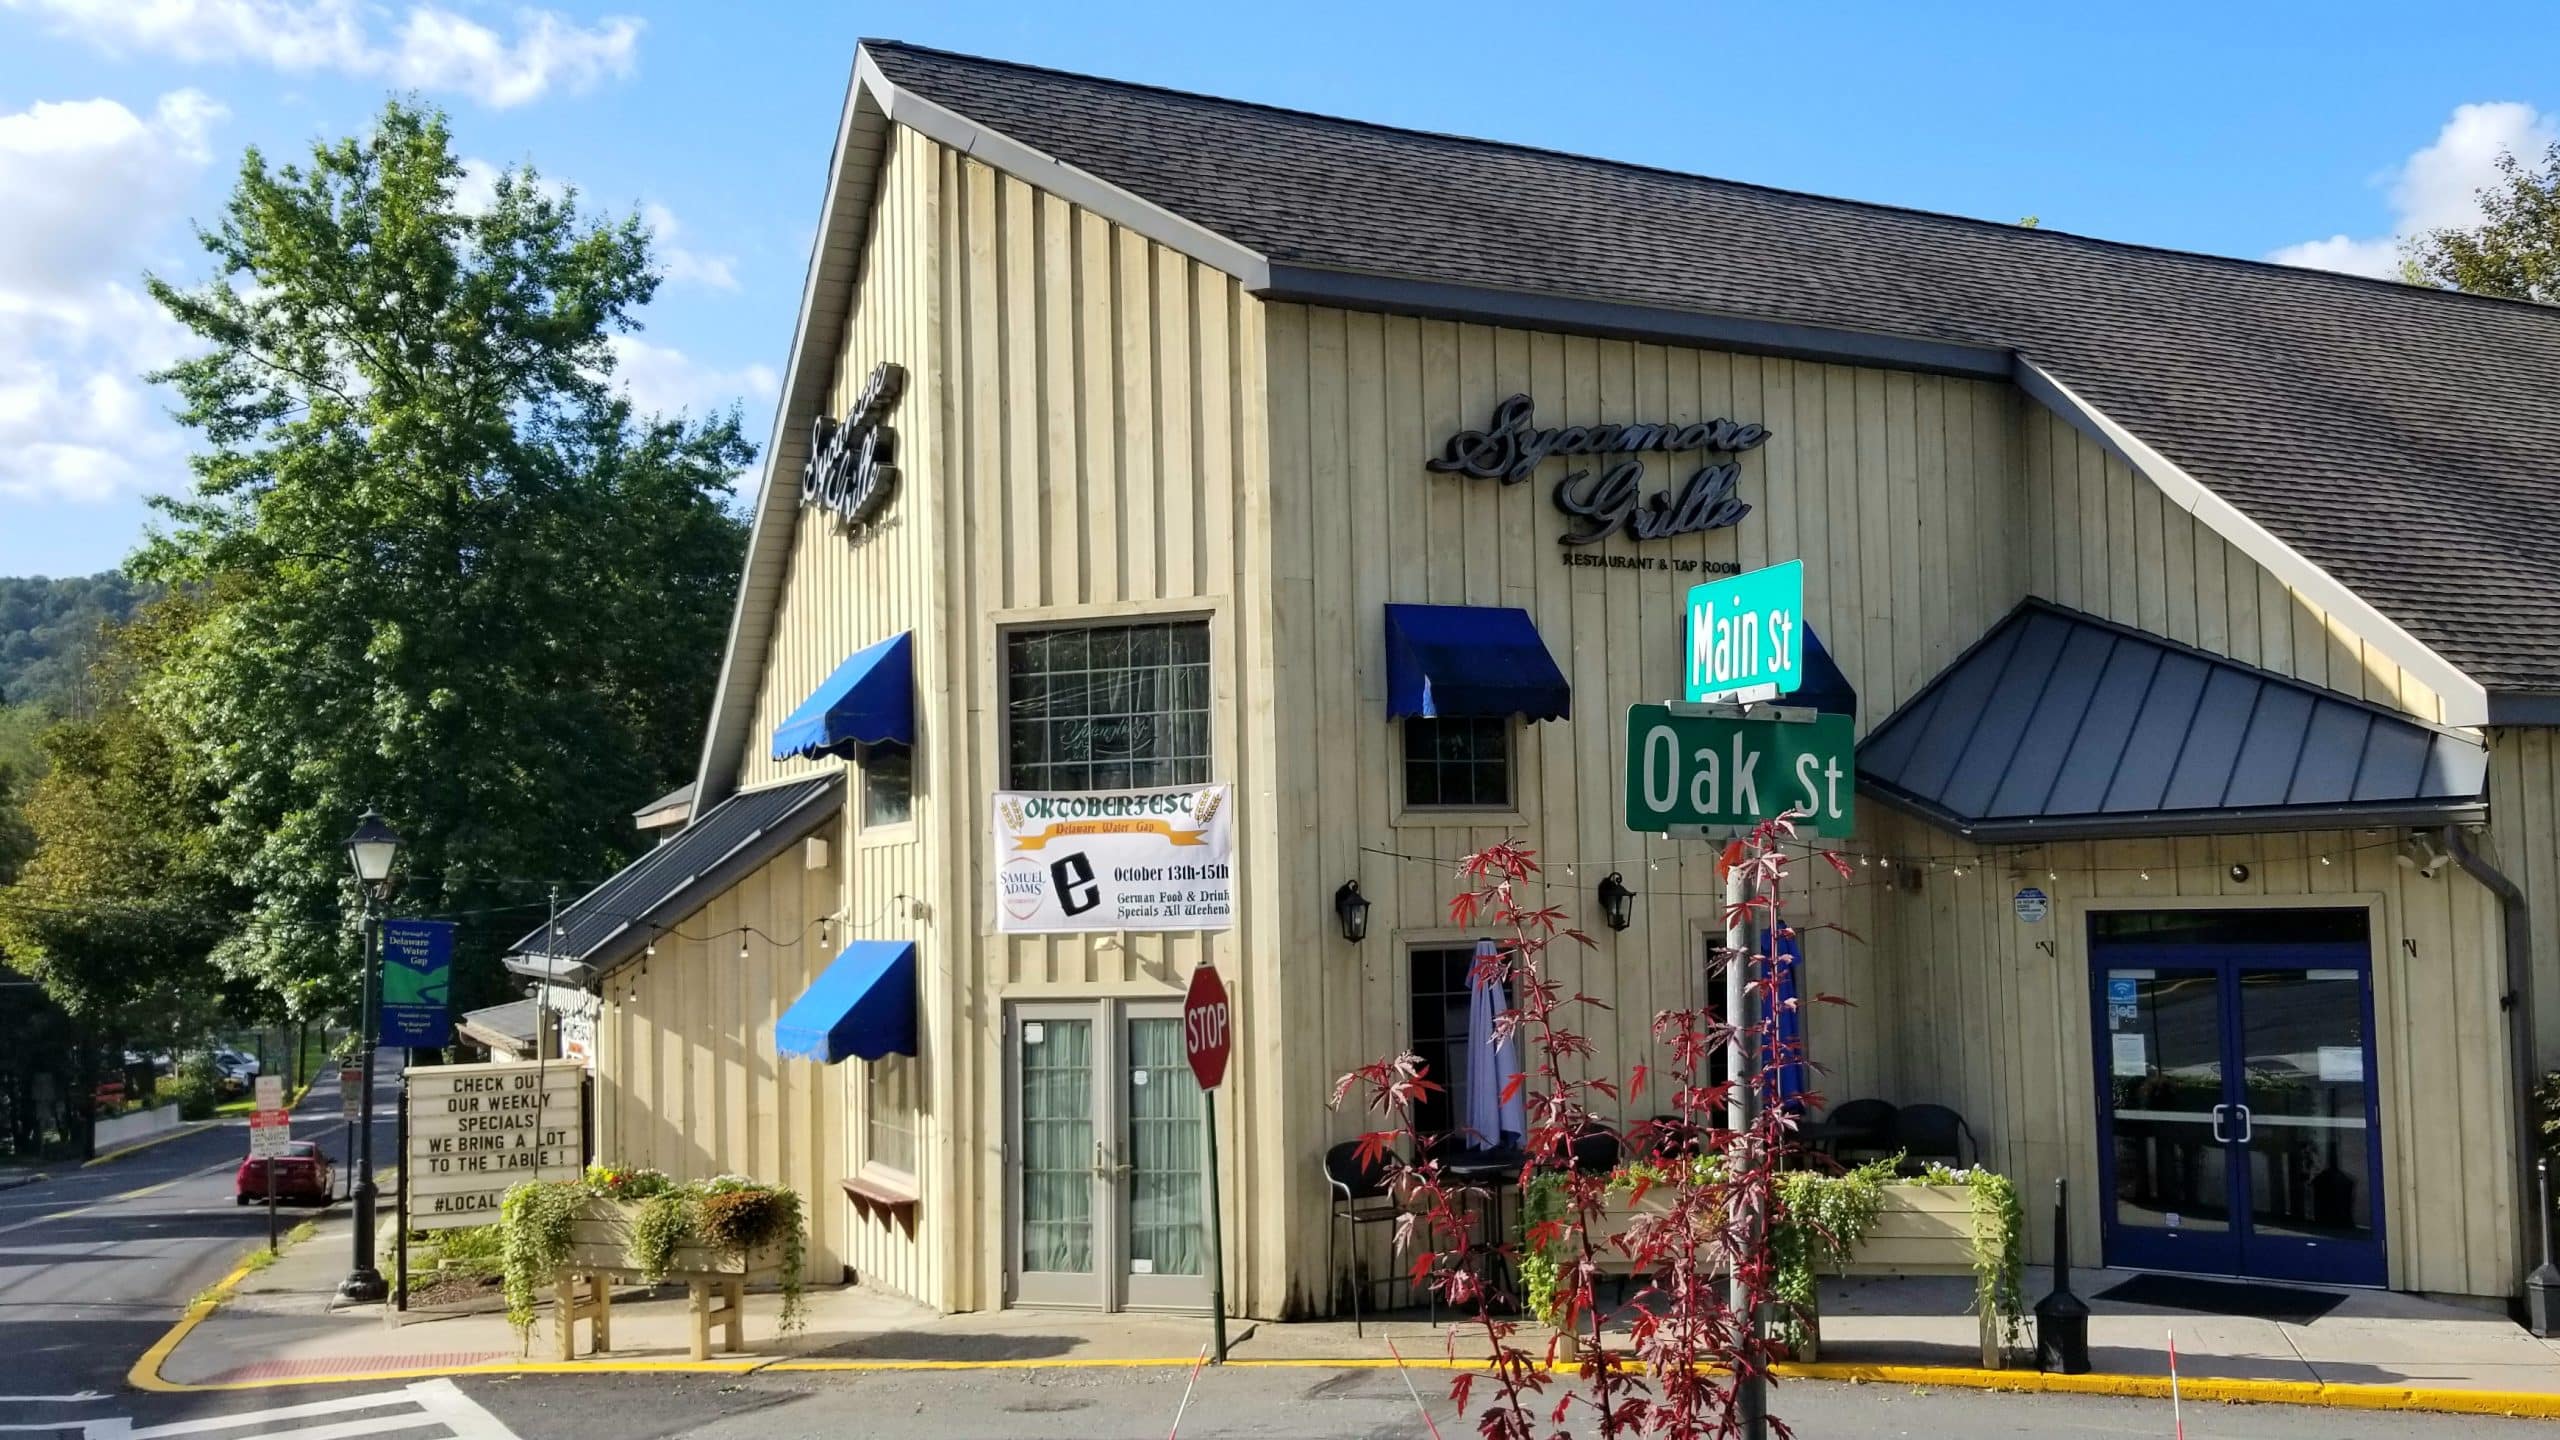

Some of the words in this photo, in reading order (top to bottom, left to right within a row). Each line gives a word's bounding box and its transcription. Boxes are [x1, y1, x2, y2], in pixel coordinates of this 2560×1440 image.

[1426, 393, 1772, 486] Sycamore
[1554, 460, 1752, 545] Grille
[1562, 552, 1655, 571] RESTAURANT
[1659, 558, 1669, 570] &
[1673, 559, 1699, 572] TAP
[1702, 562, 1742, 576] ROOM
[1692, 595, 1759, 687] Main
[1767, 608, 1793, 673] St
[1643, 724, 1761, 816] Oak
[1794, 752, 1843, 819] St
[1024, 792, 1194, 822] OKTOBERFEST
[1056, 823, 1096, 834] Delaware
[1102, 821, 1129, 833] Water
[1136, 821, 1155, 833] Gap
[1000, 871, 1046, 885] SAMUEL
[1114, 866, 1163, 882] October
[1168, 863, 1230, 881] 13th-15th
[1004, 883, 1043, 897] ADAMS
[1117, 892, 1155, 904] German
[1159, 890, 1183, 903] Food
[1186, 890, 1196, 902] &
[1200, 888, 1230, 902] Drink
[1118, 904, 1159, 919] Specials
[1164, 904, 1181, 917] All
[1185, 902, 1231, 916] Weekend
[389, 936, 430, 946] Delaware
[402, 946, 429, 956] Water
[410, 956, 429, 968] Gap
[1188, 1002, 1227, 1054] STOP
[341, 1055, 363, 1068] 25
[454, 1077, 504, 1093] CHECK
[448, 1097, 479, 1113] OUR
[489, 1093, 551, 1110] WEEKLY
[429, 1138, 452, 1153] WE
[459, 1135, 504, 1151] BRING
[515, 1133, 526, 1148] A
[429, 1157, 449, 1173] TO
[458, 1155, 487, 1171] THE
[434, 1193, 498, 1212] #LOCAL
